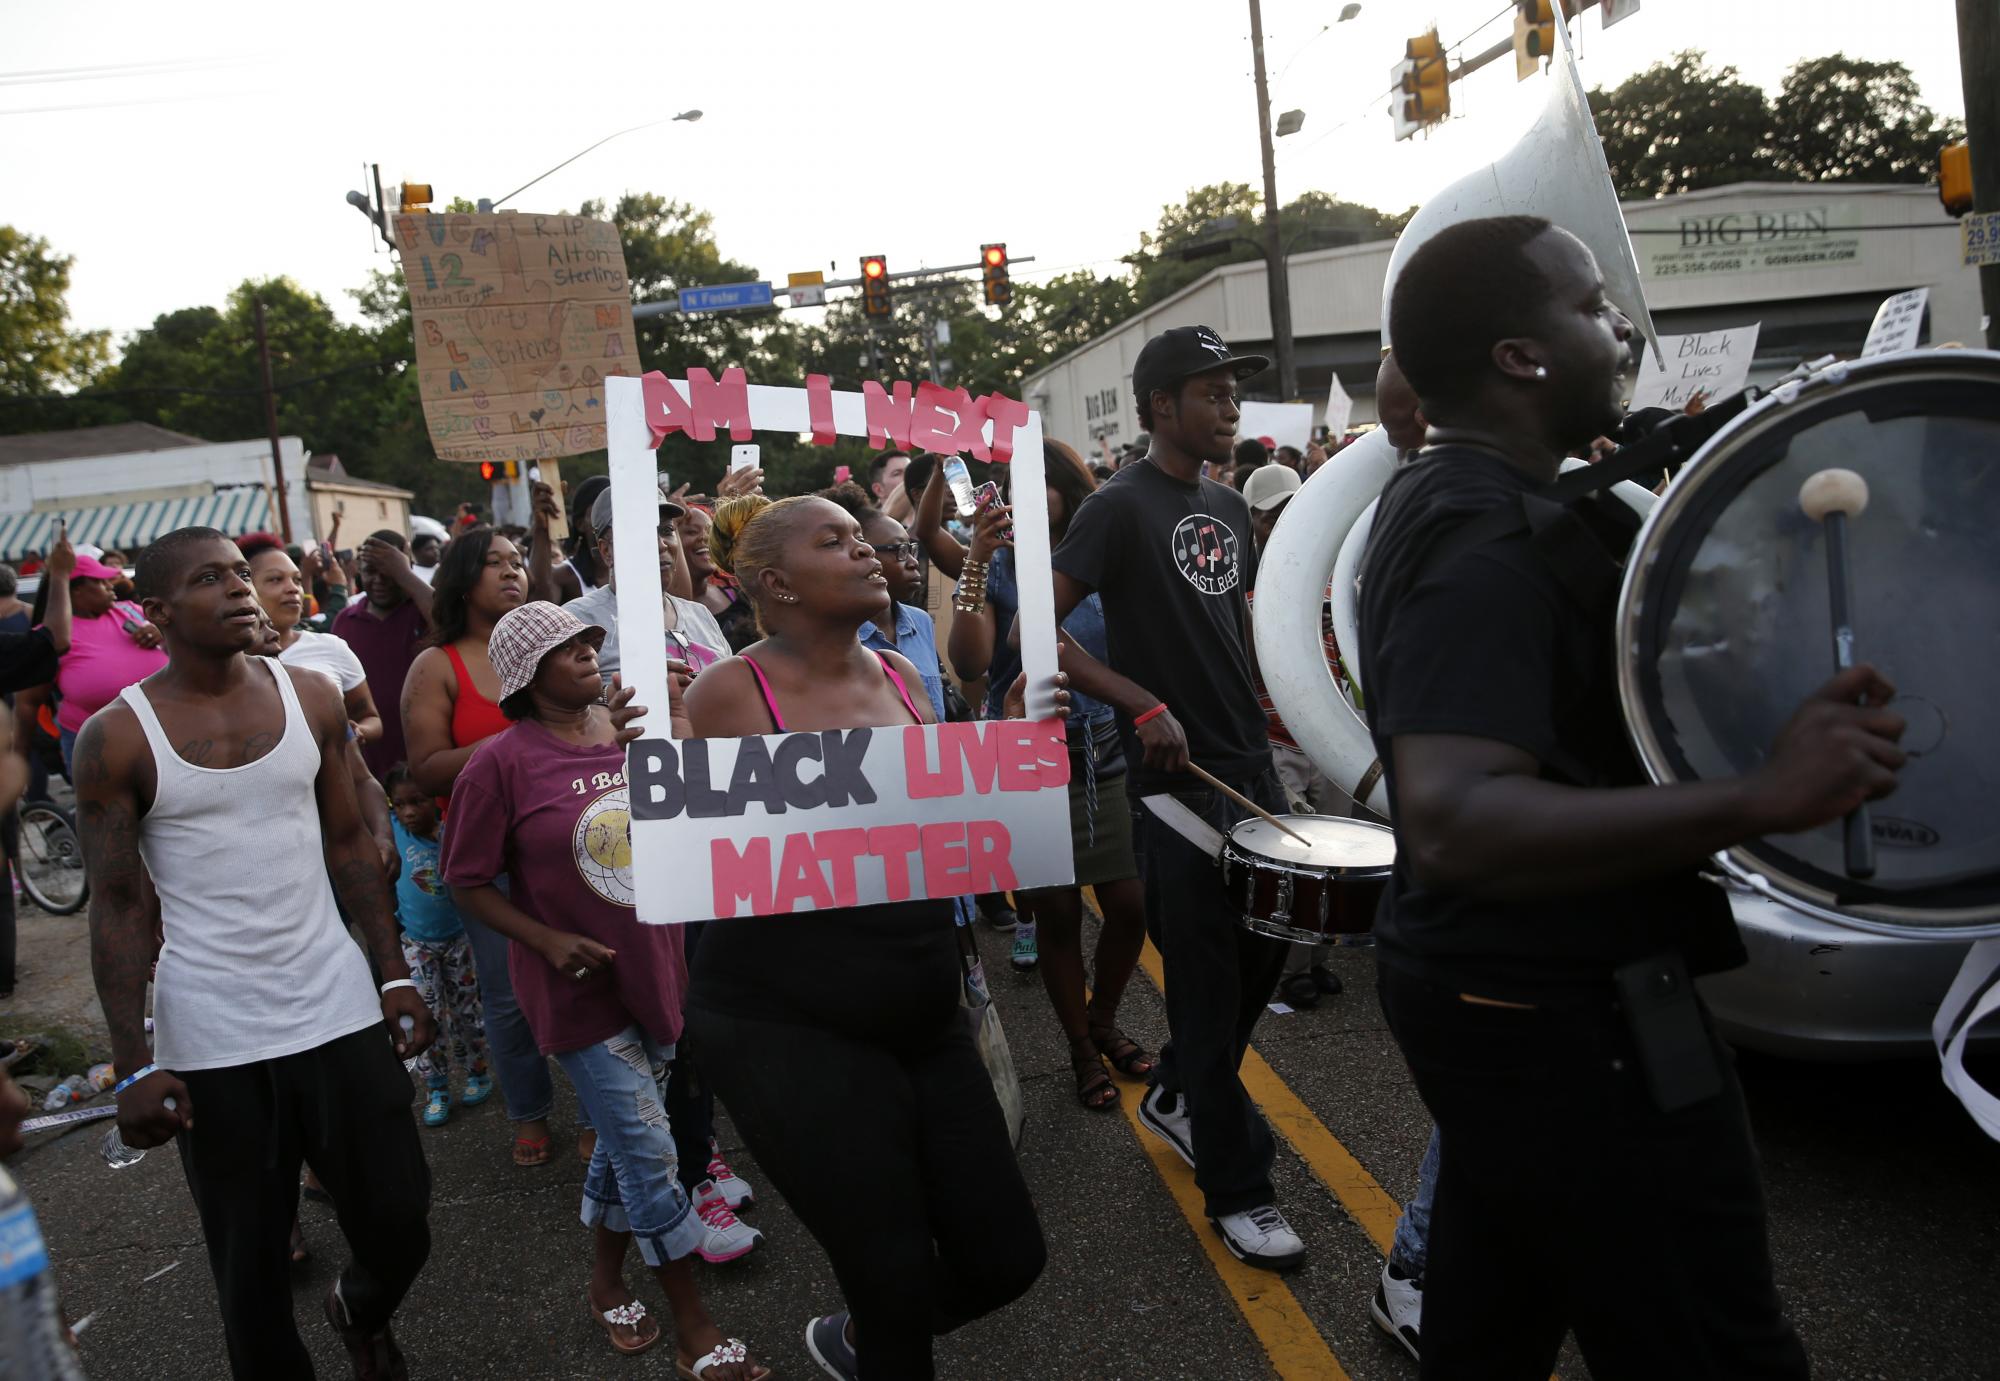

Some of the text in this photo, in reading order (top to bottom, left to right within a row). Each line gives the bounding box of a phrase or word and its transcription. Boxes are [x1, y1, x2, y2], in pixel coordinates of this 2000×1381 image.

[1680, 207, 1828, 247] BIG BEN
[549, 243, 610, 266] Alton
[421, 253, 477, 291] 12
[553, 267, 624, 292] Sterling
[1678, 334, 1731, 358] Black
[1681, 362, 1722, 379] Lives
[642, 367, 1029, 464] AM I NEXT
[1085, 387, 1117, 420] BIG BEN
[1183, 562, 1214, 593] LAST
[627, 719, 1071, 820] BLACK LIVES
[572, 778, 587, 795] I
[710, 820, 1019, 918] MATTER
